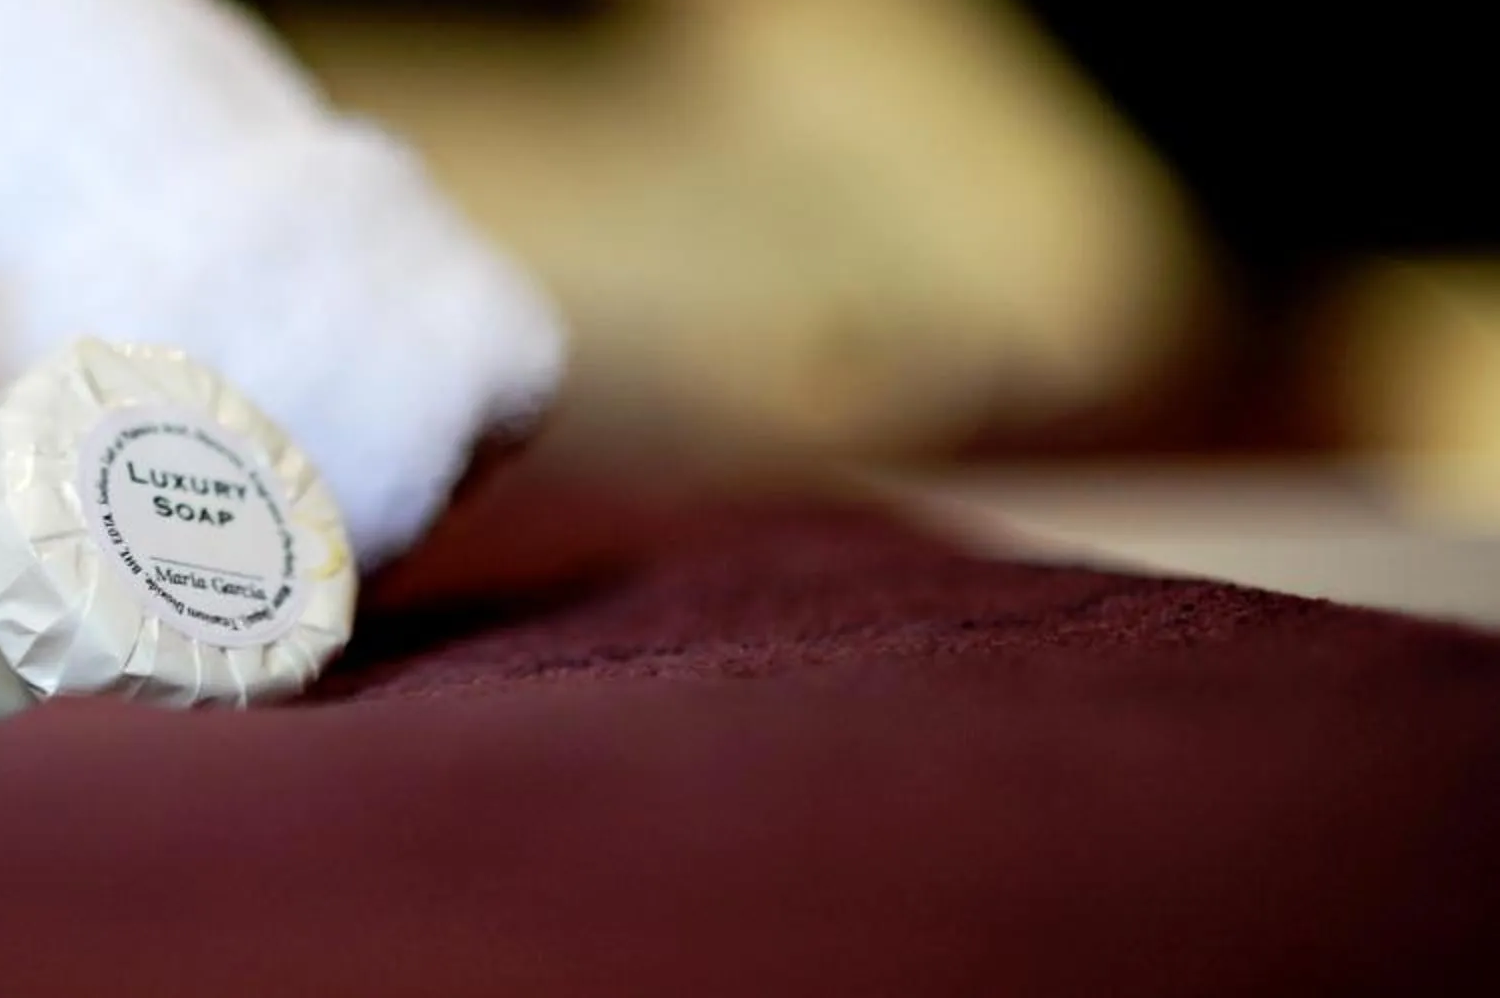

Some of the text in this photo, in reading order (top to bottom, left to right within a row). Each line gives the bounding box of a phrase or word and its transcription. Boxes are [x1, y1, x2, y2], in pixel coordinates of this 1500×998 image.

[126, 461, 246, 499] LUXURY
[152, 495, 236, 526] SOAP
[152, 564, 207, 591] Maria
